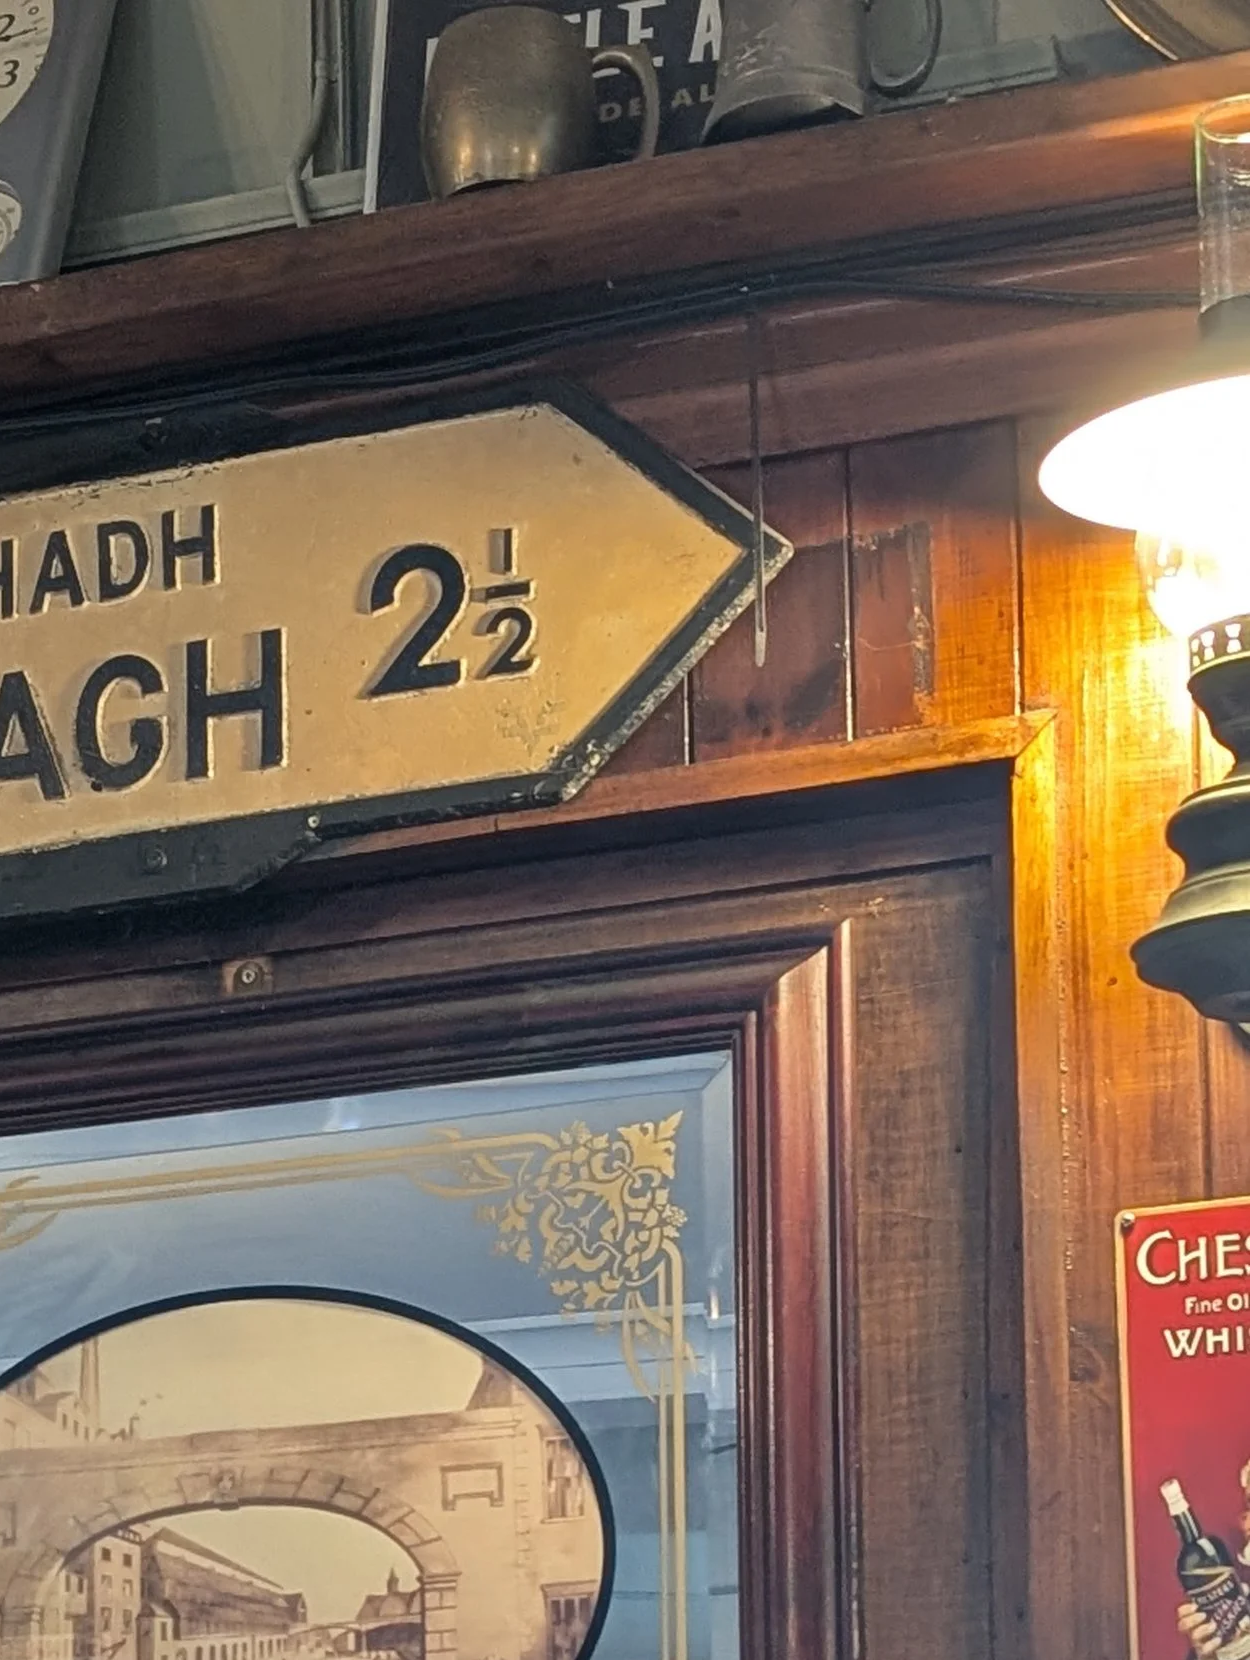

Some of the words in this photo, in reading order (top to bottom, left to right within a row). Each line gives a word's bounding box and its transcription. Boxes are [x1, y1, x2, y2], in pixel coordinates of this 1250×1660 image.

[1136, 1229, 1250, 1286] CHE
[1184, 1295, 1224, 1316] Fine
[1163, 1325, 1250, 1359] WHI
